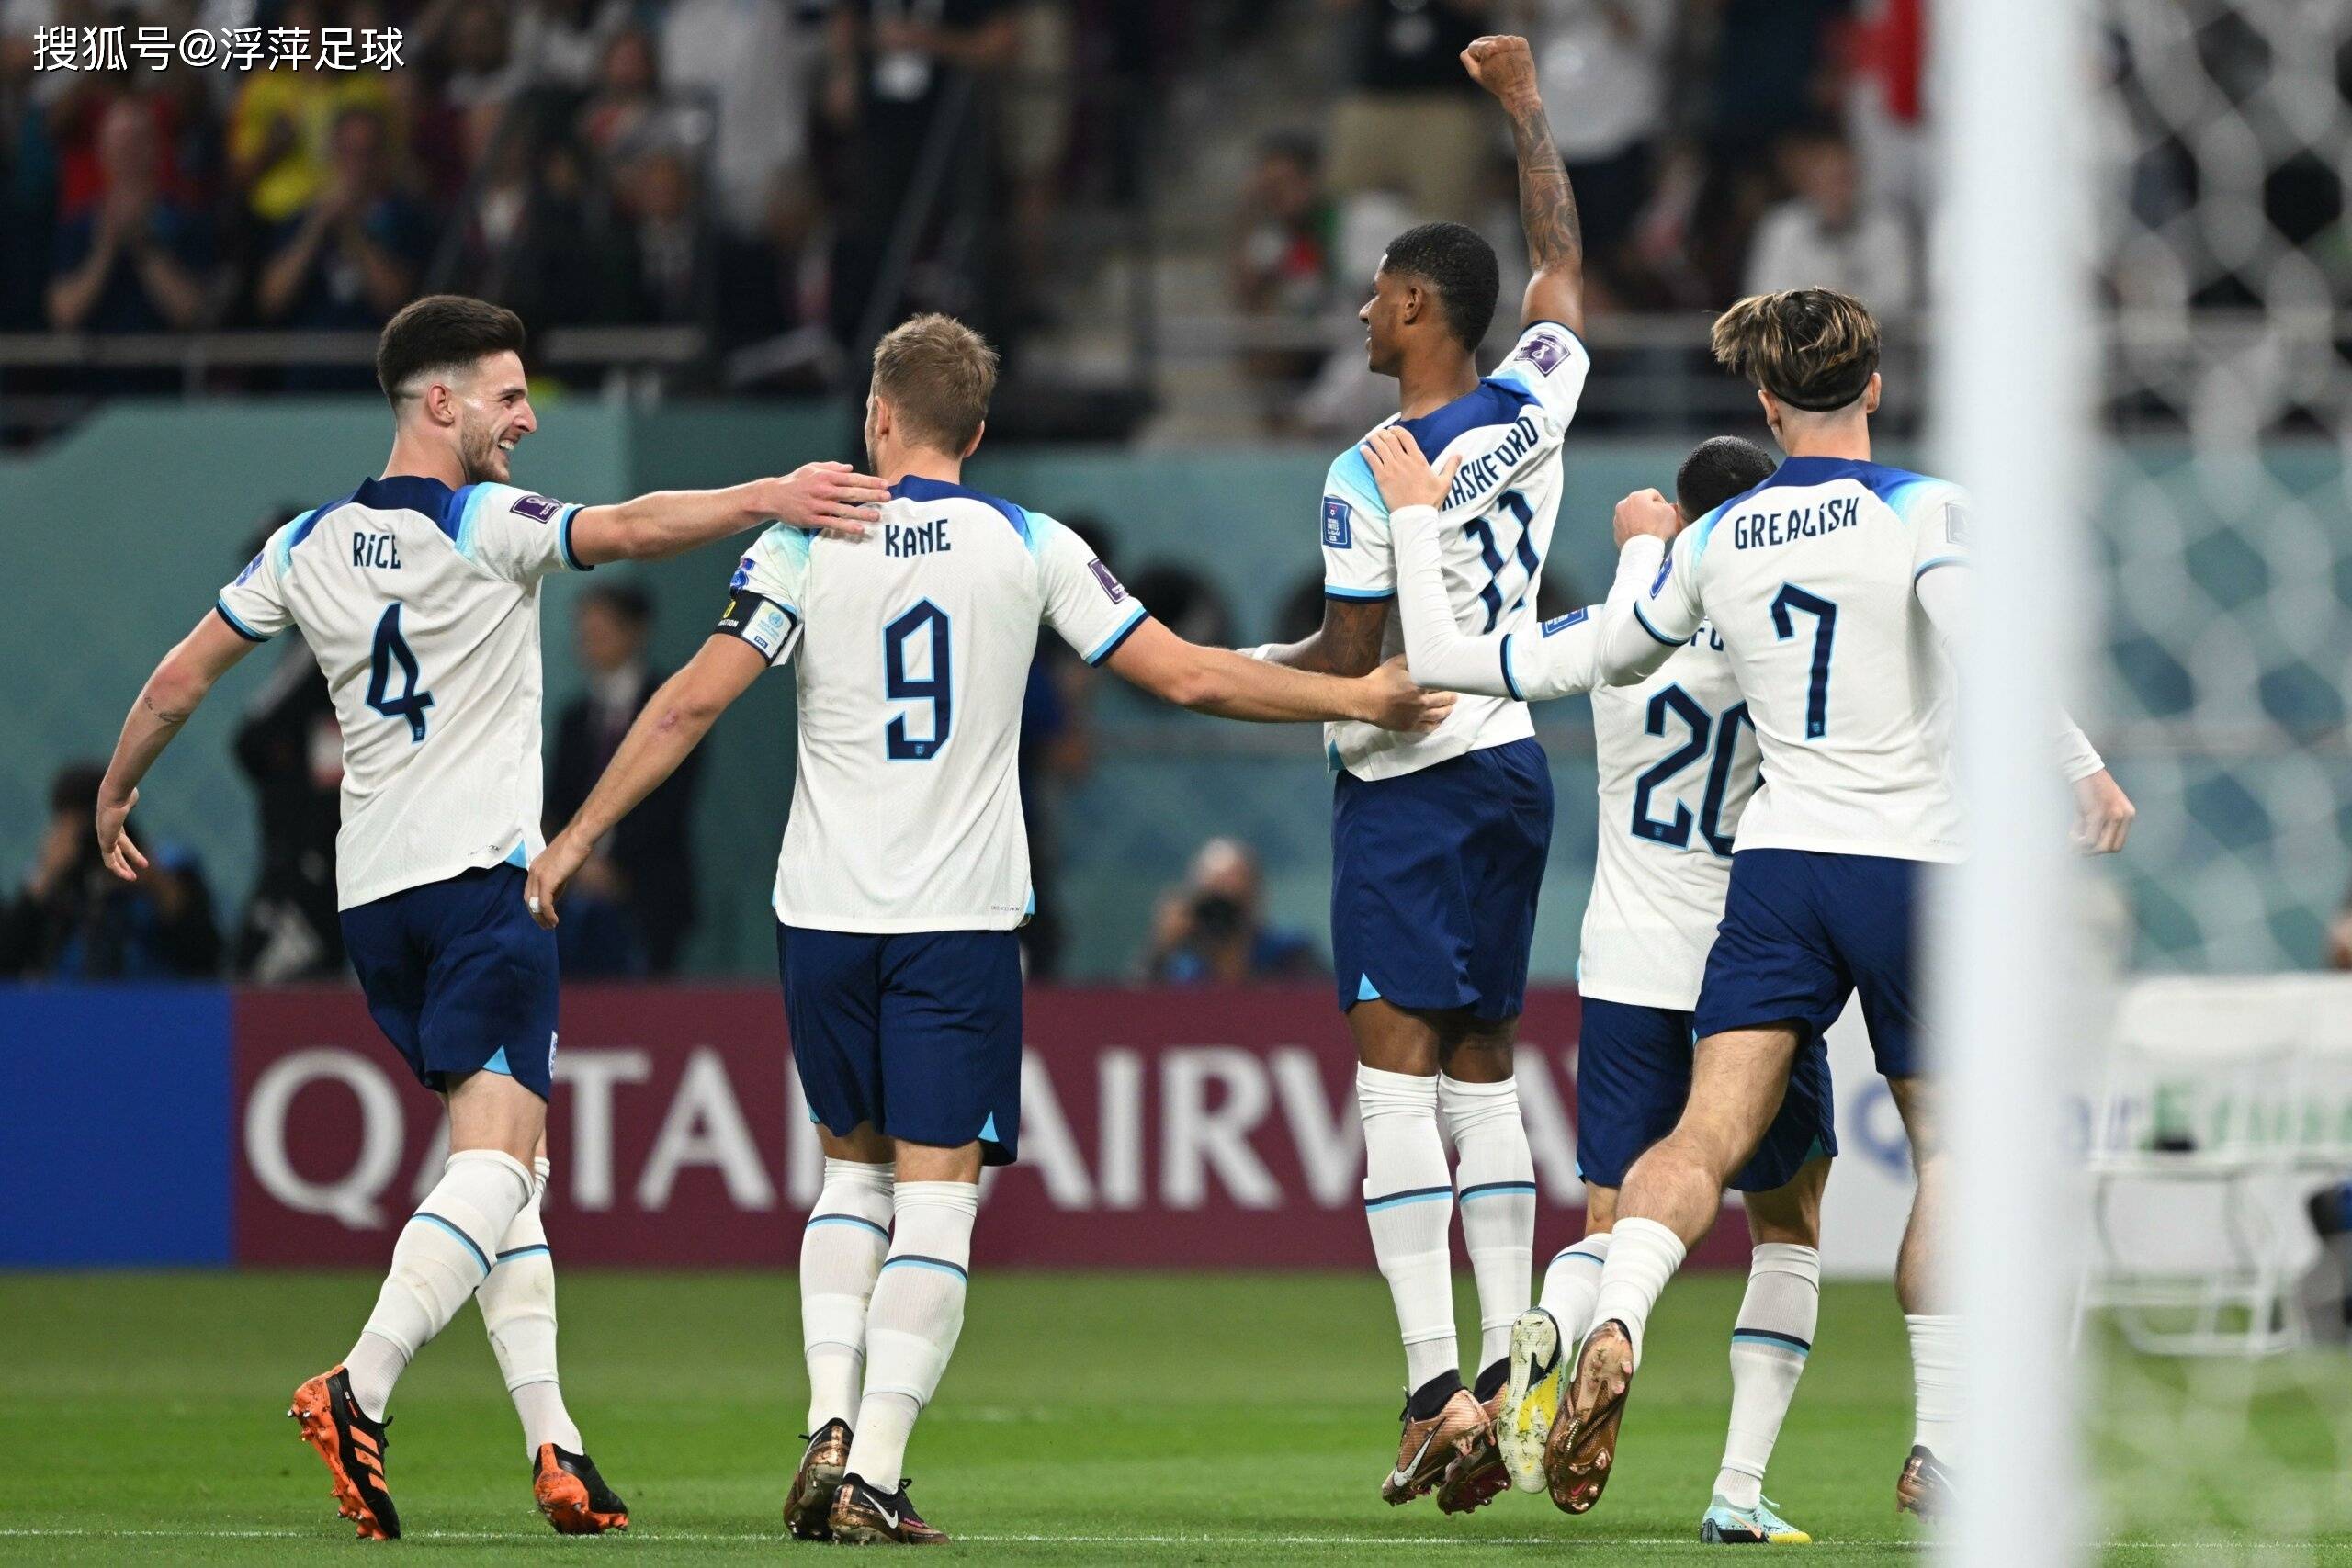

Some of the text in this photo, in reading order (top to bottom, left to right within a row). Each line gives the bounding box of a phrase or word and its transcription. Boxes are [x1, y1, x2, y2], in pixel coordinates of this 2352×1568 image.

[885, 519, 951, 558] KANE
[1464, 490, 1540, 635] 11
[365, 601, 436, 743] 4
[883, 595, 953, 761] 9
[1770, 581, 1838, 740] 7
[1632, 681, 1765, 859] 20
